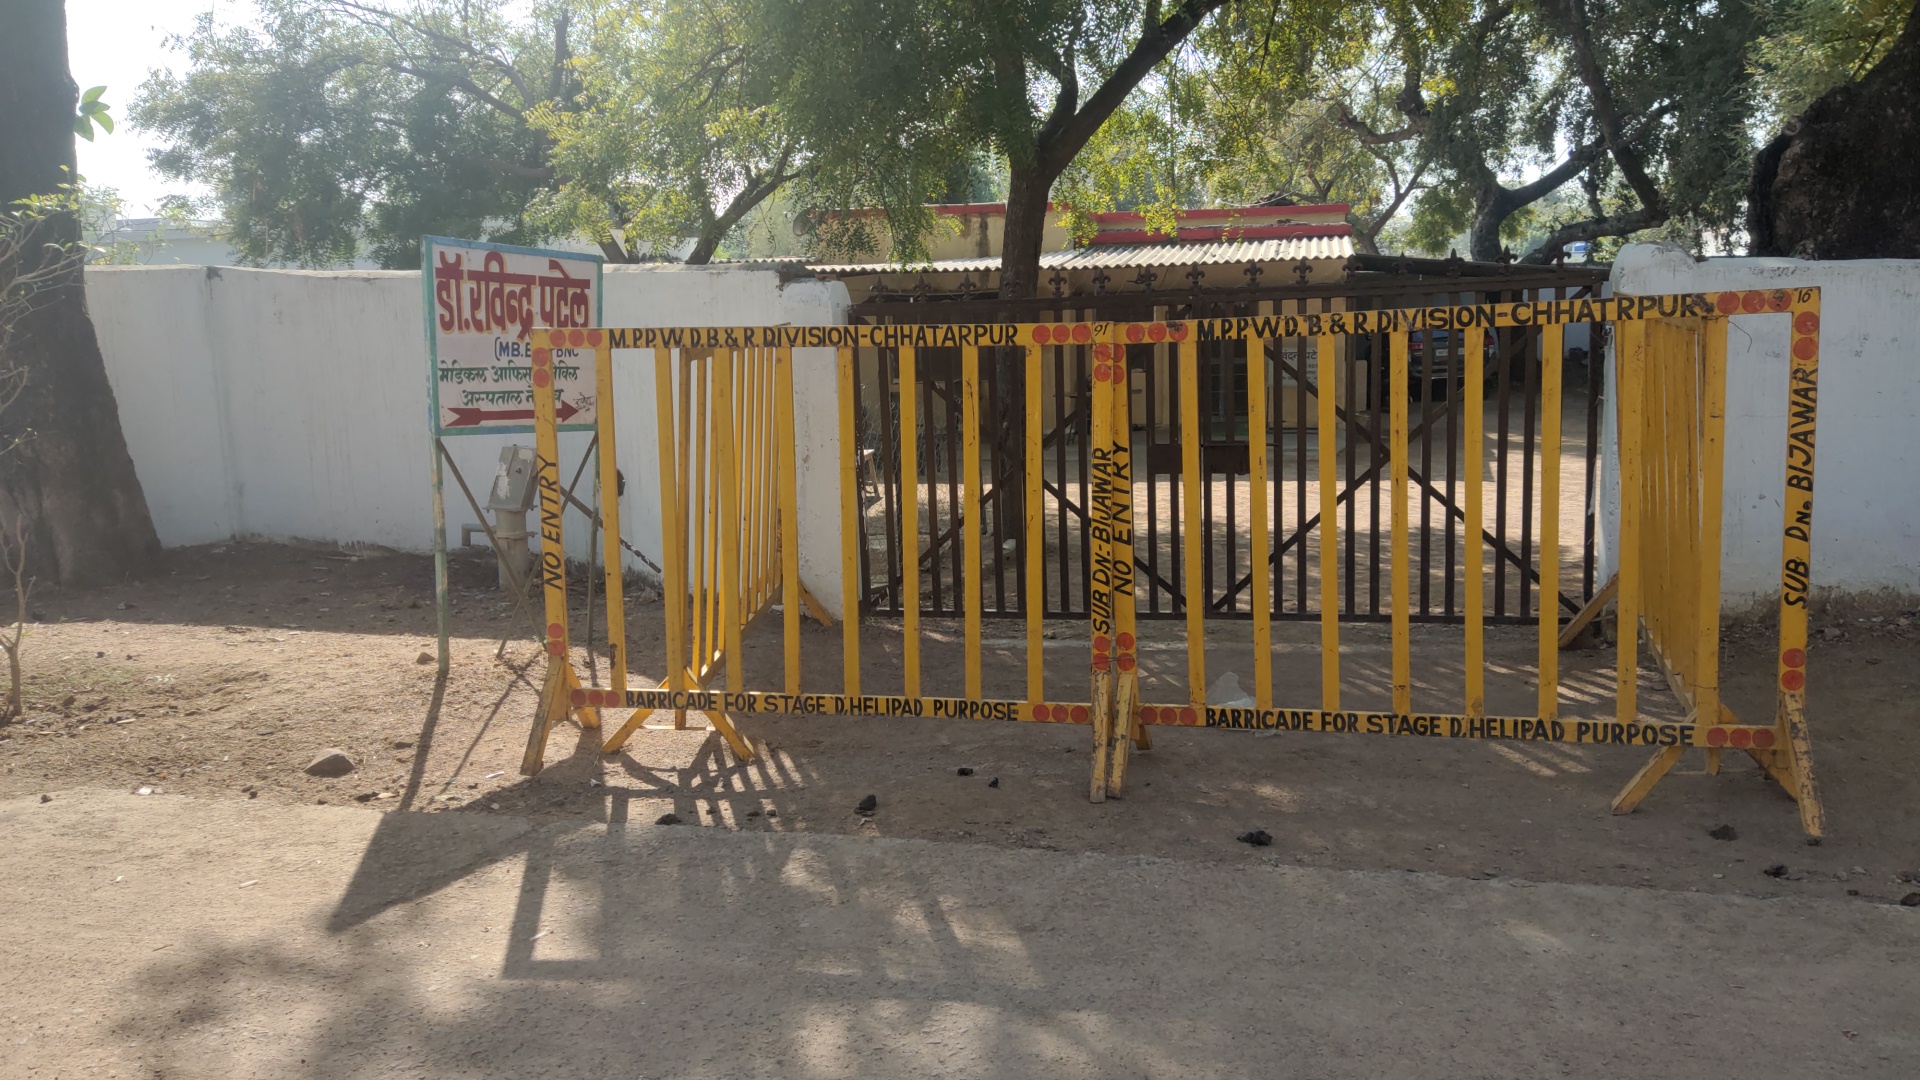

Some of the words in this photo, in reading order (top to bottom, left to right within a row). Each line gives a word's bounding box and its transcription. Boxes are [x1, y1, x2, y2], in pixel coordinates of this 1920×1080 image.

[538, 259, 591, 328] पटेल
[1797, 289, 1812, 304] 16
[491, 359, 532, 387] आफिस
[1787, 367, 1818, 492] BIJAWAR
[537, 454, 561, 545] ENTRY
[1112, 440, 1132, 546] ENTRY
[543, 552, 563, 591] NO
[1113, 560, 1132, 596] NO
[1784, 558, 1810, 609] SUB
[1092, 589, 1111, 635] SUB
[625, 690, 718, 712] BARRICADE
[724, 693, 756, 713] FOR
[763, 695, 827, 715] STAGE
[933, 700, 1019, 722] PURPOSE
[1205, 708, 1314, 731] BARRICADE
[1321, 711, 1360, 733] FOR
[1366, 714, 1442, 737] STAGE
[1577, 722, 1695, 748] PURPOSE
